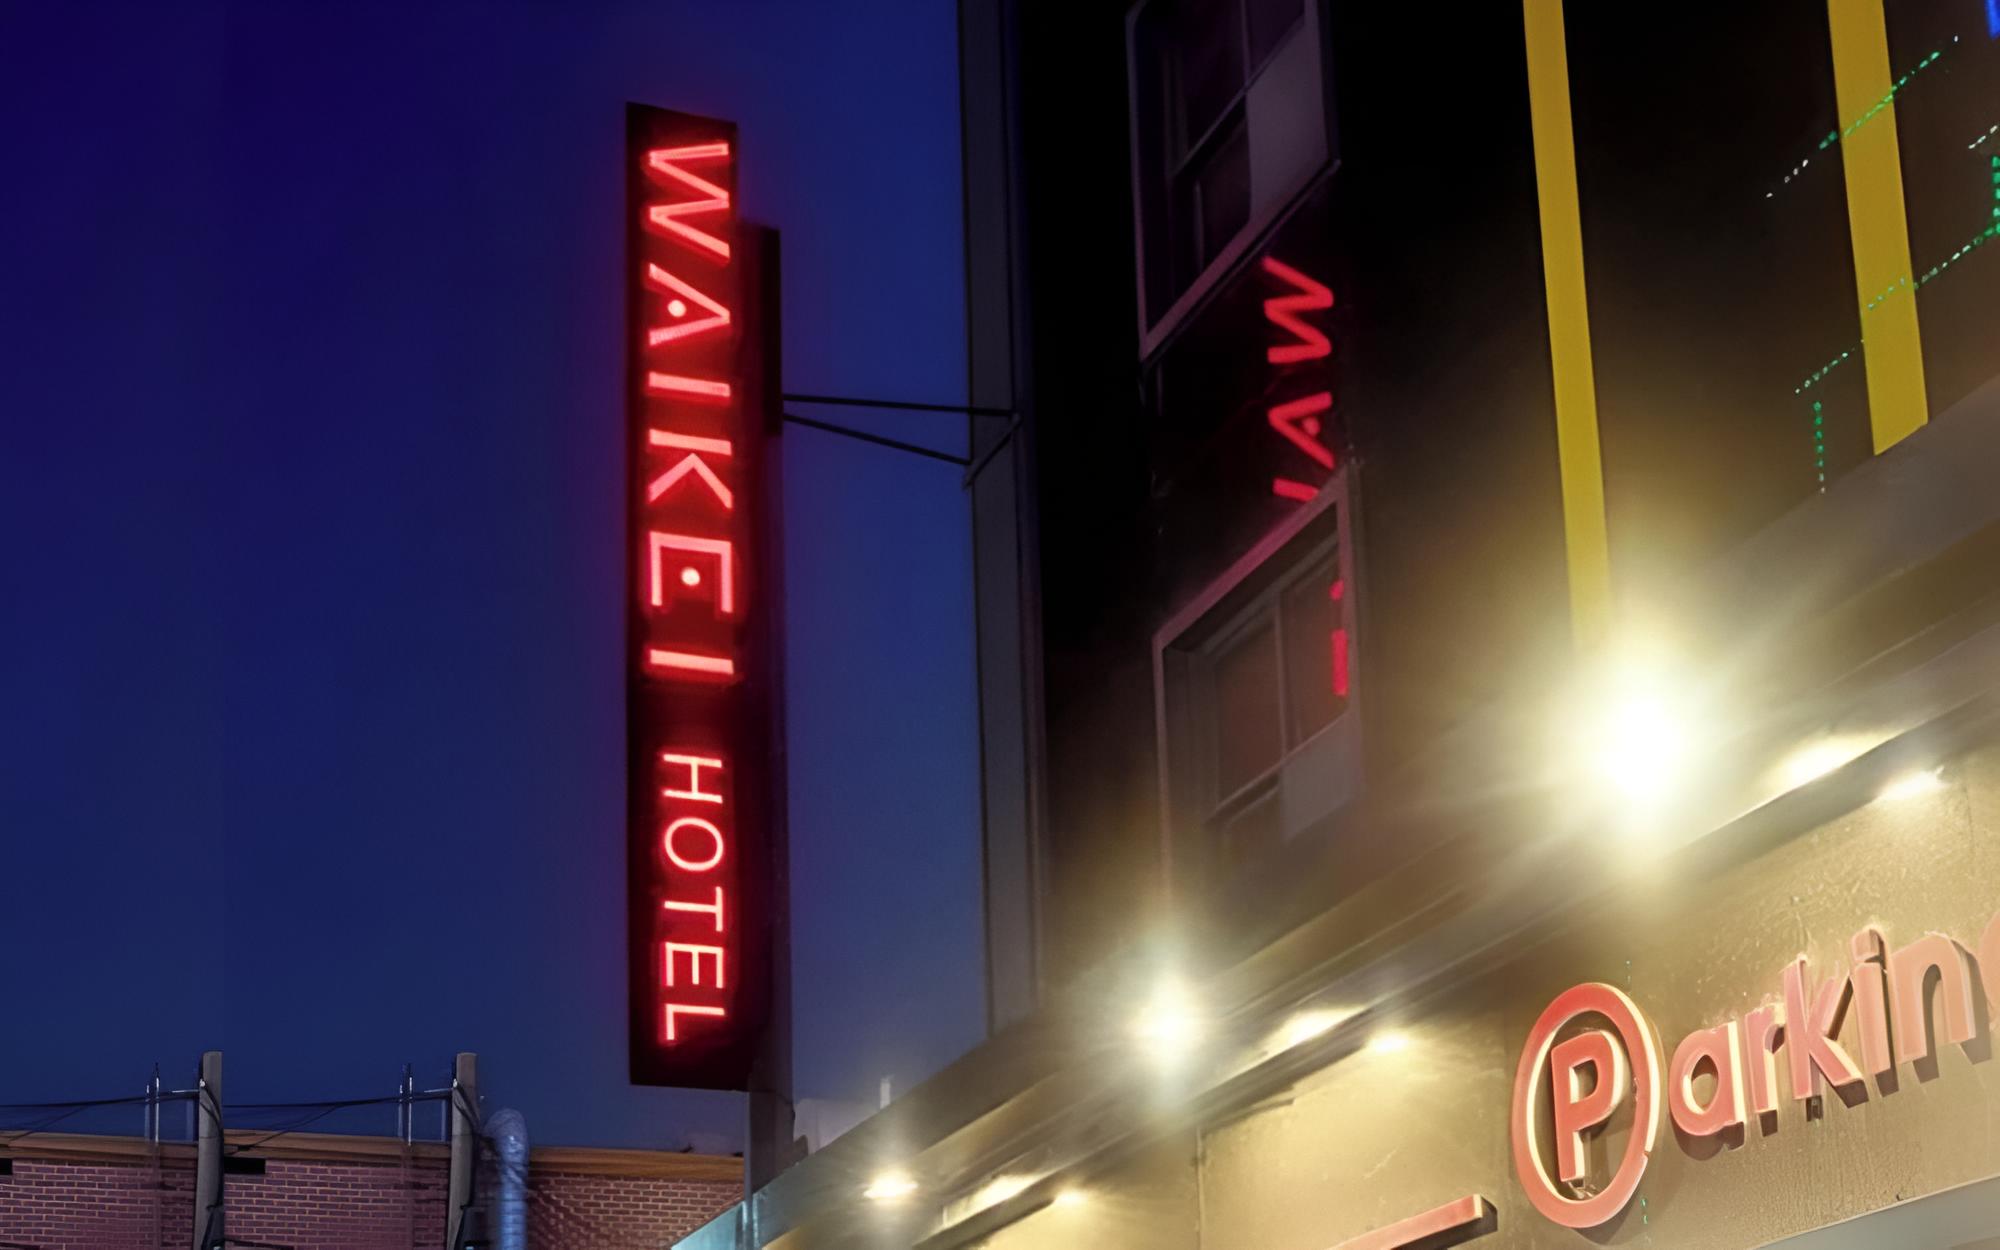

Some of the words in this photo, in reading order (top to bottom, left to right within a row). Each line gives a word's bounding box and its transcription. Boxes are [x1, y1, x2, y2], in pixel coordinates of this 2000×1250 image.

[648, 141, 734, 676] WAIKEI
[661, 752, 725, 1041] HOTEL
[1550, 910, 2000, 1184] Parkin
